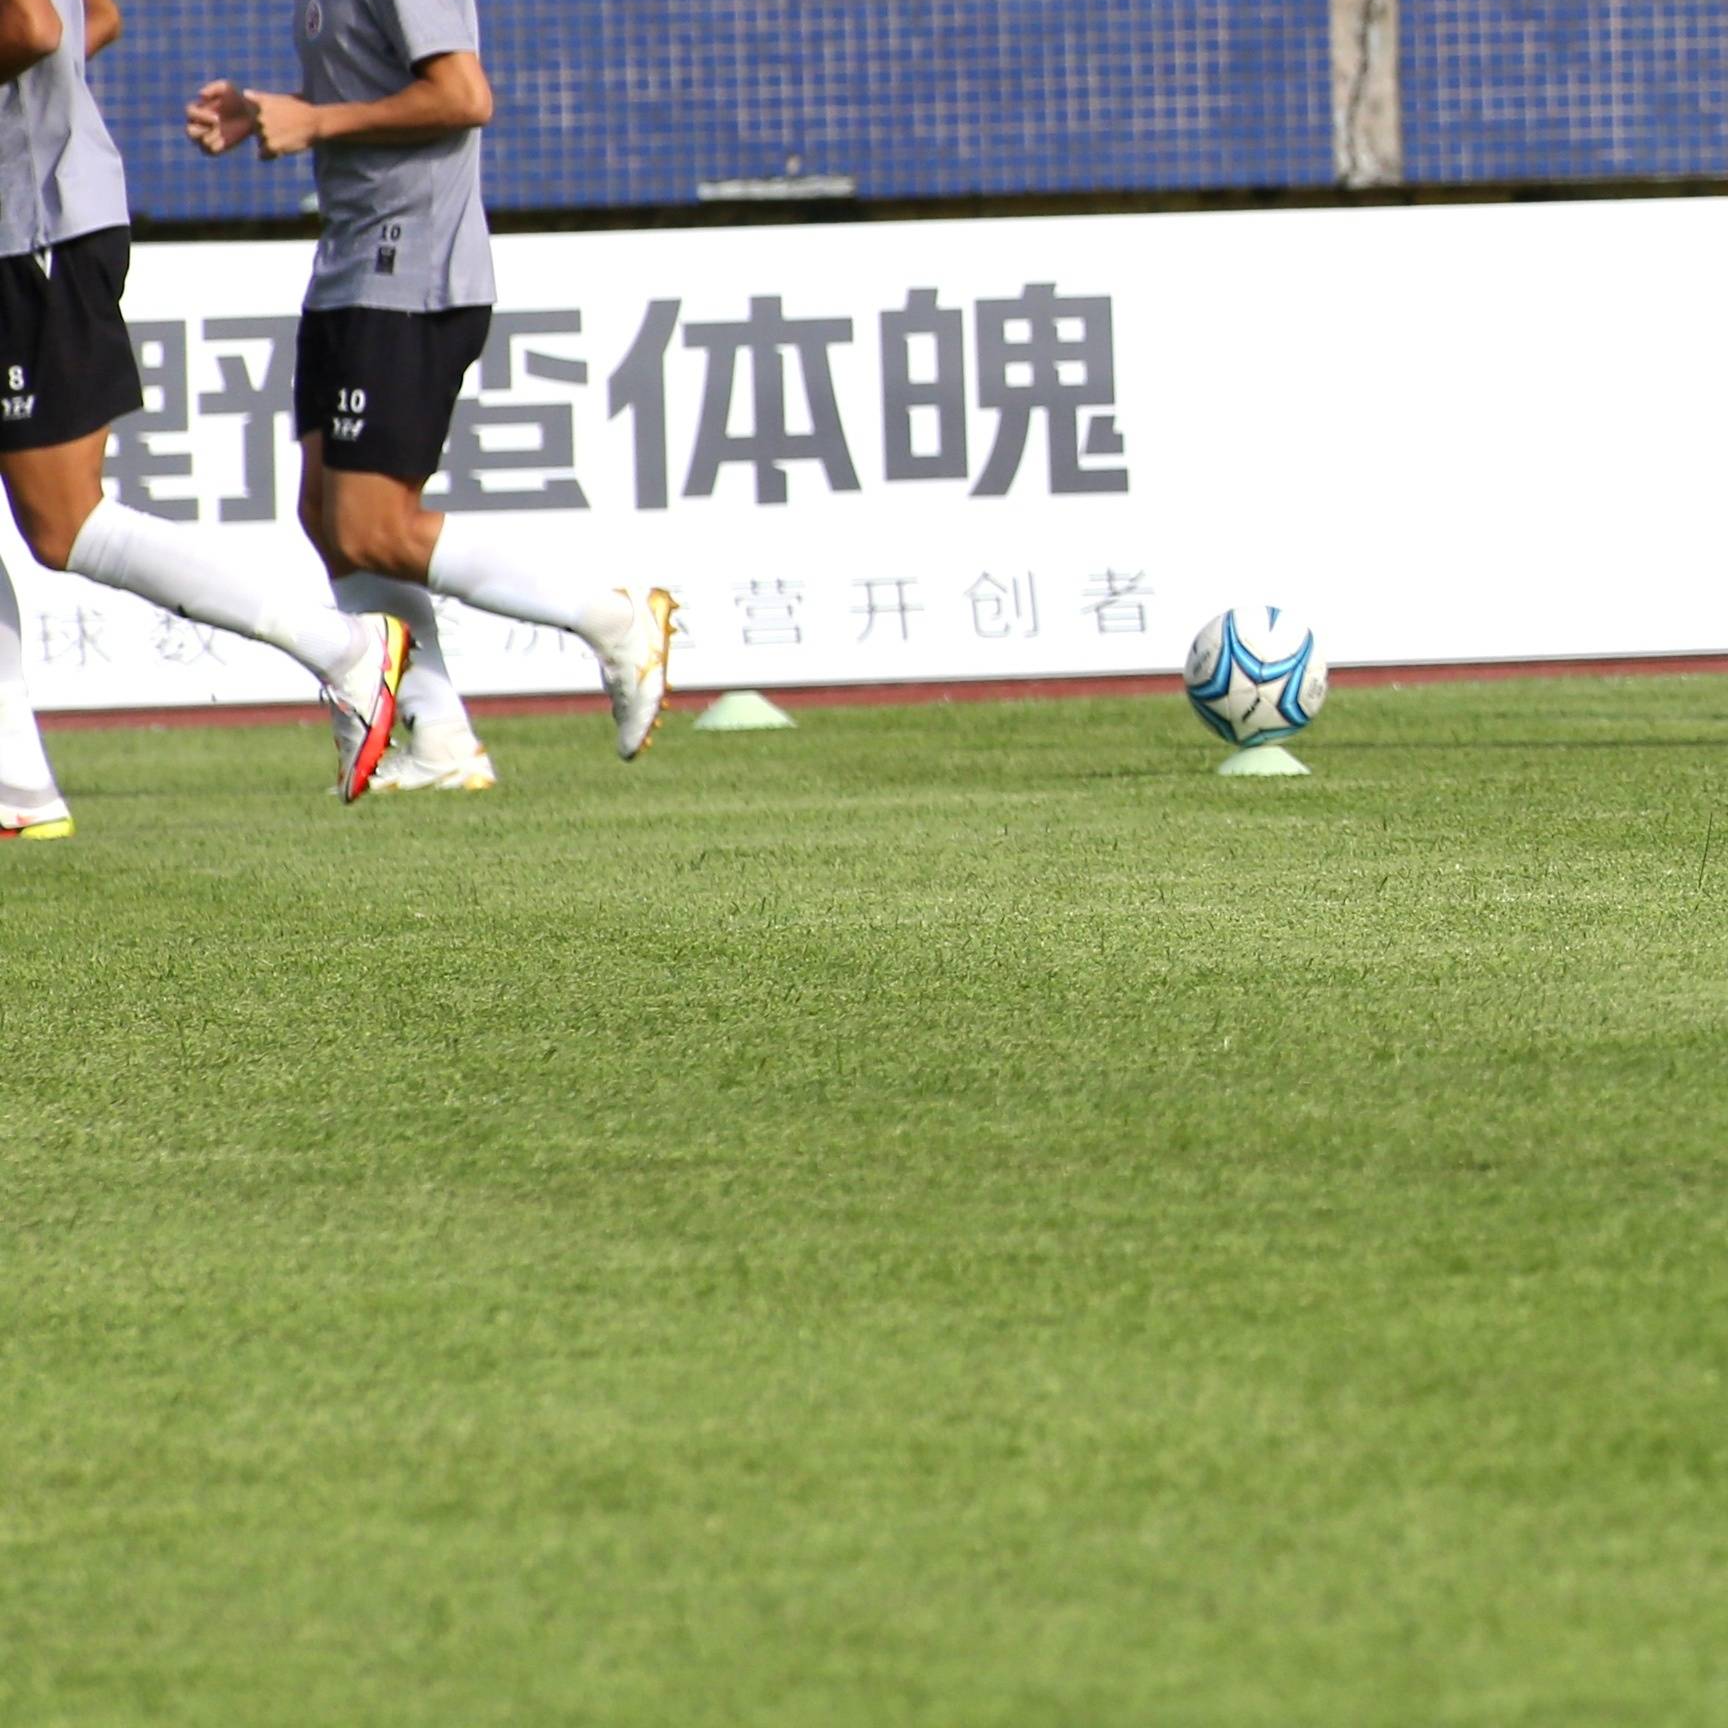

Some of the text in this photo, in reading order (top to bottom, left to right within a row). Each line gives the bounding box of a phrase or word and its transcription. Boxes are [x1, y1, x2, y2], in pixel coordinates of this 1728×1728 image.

[380, 224, 401, 241] 10
[8, 365, 25, 391] 8
[338, 389, 366, 414] 10
